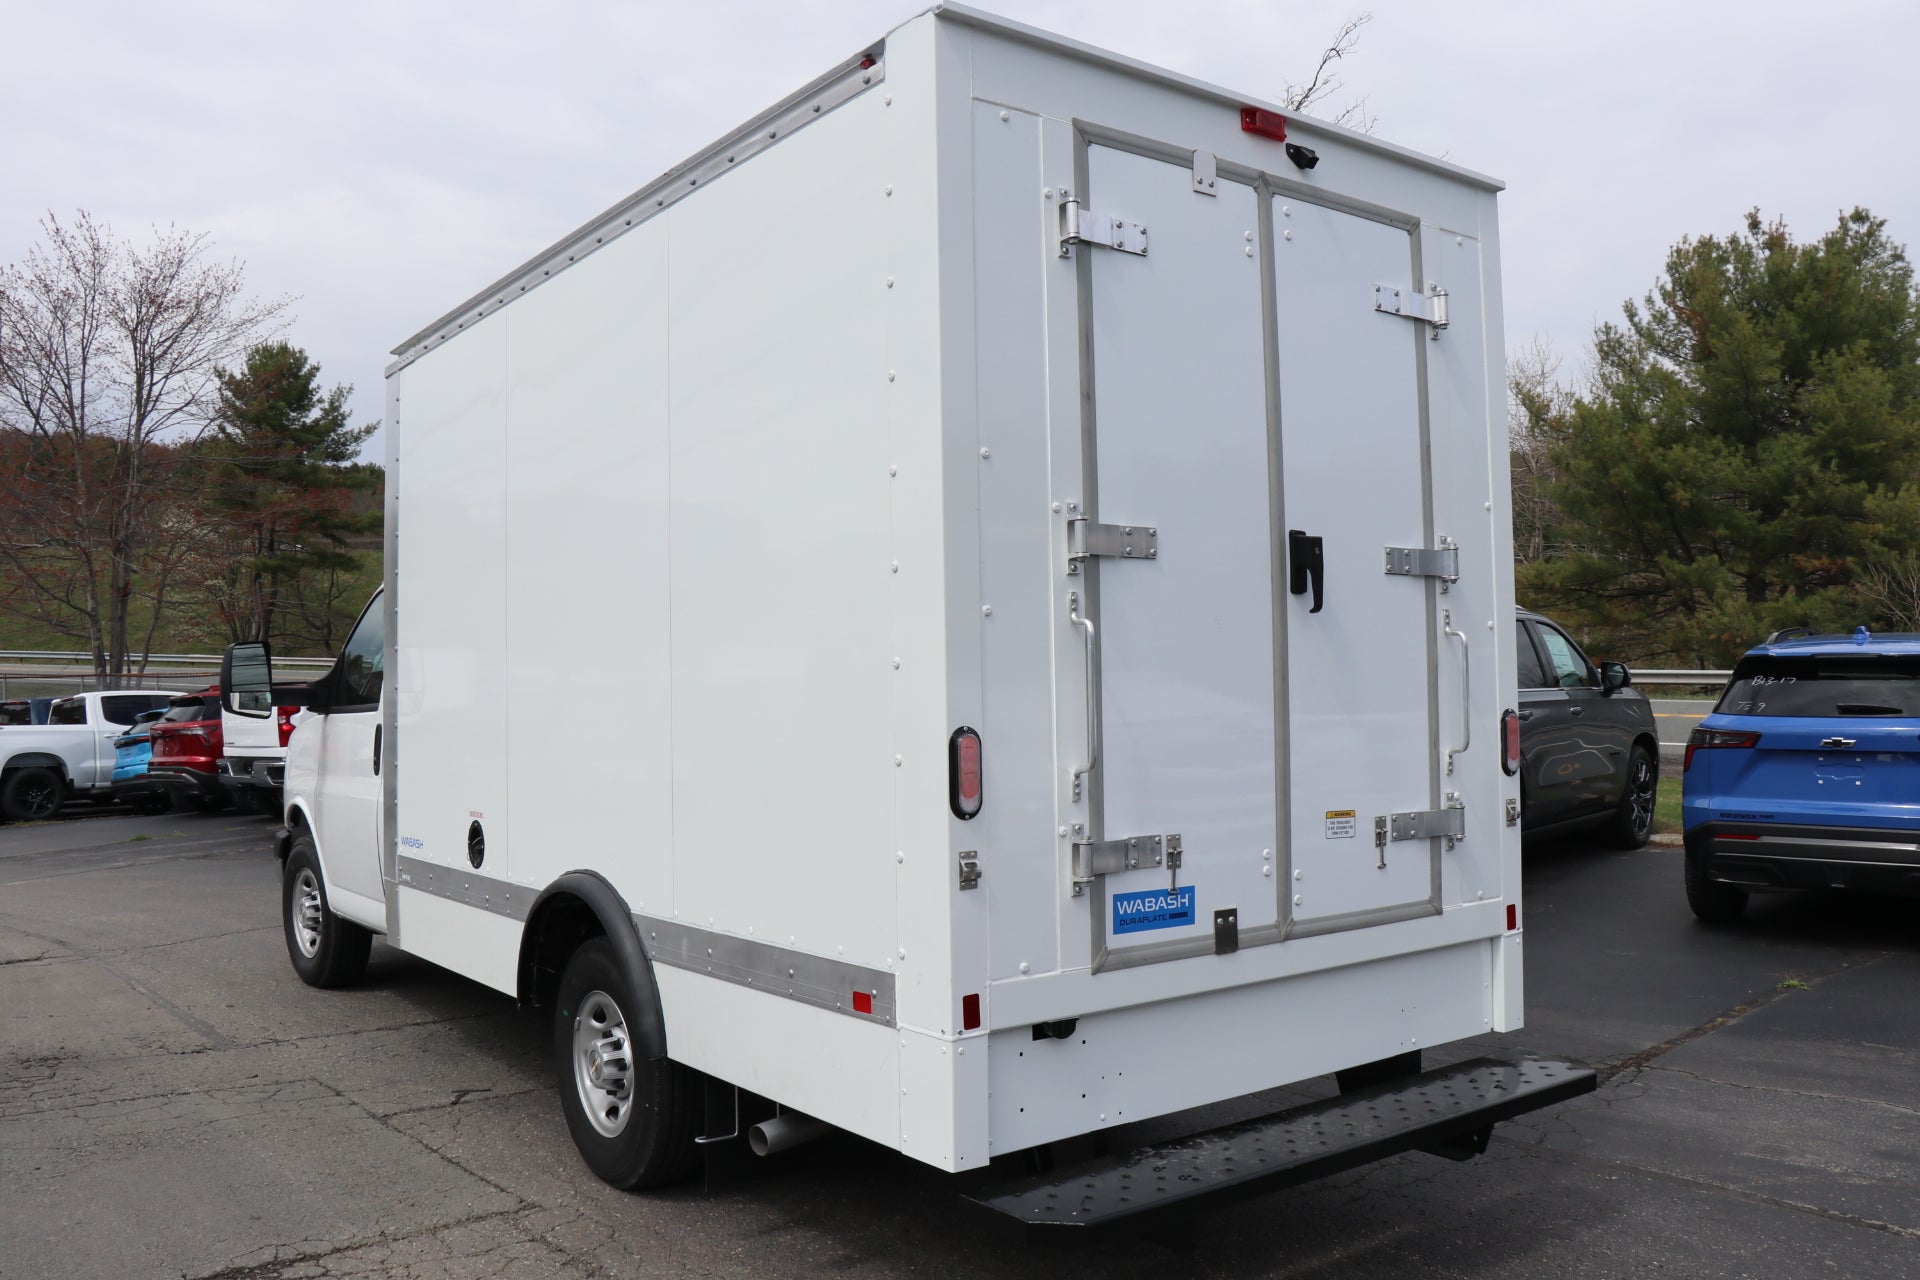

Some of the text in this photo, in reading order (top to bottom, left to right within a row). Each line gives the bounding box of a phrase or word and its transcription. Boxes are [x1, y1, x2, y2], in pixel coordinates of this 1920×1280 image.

[400, 836, 424, 849] WABASH
[1117, 893, 1189, 915] WABASH
[1119, 913, 1167, 926] DURAPLATE
